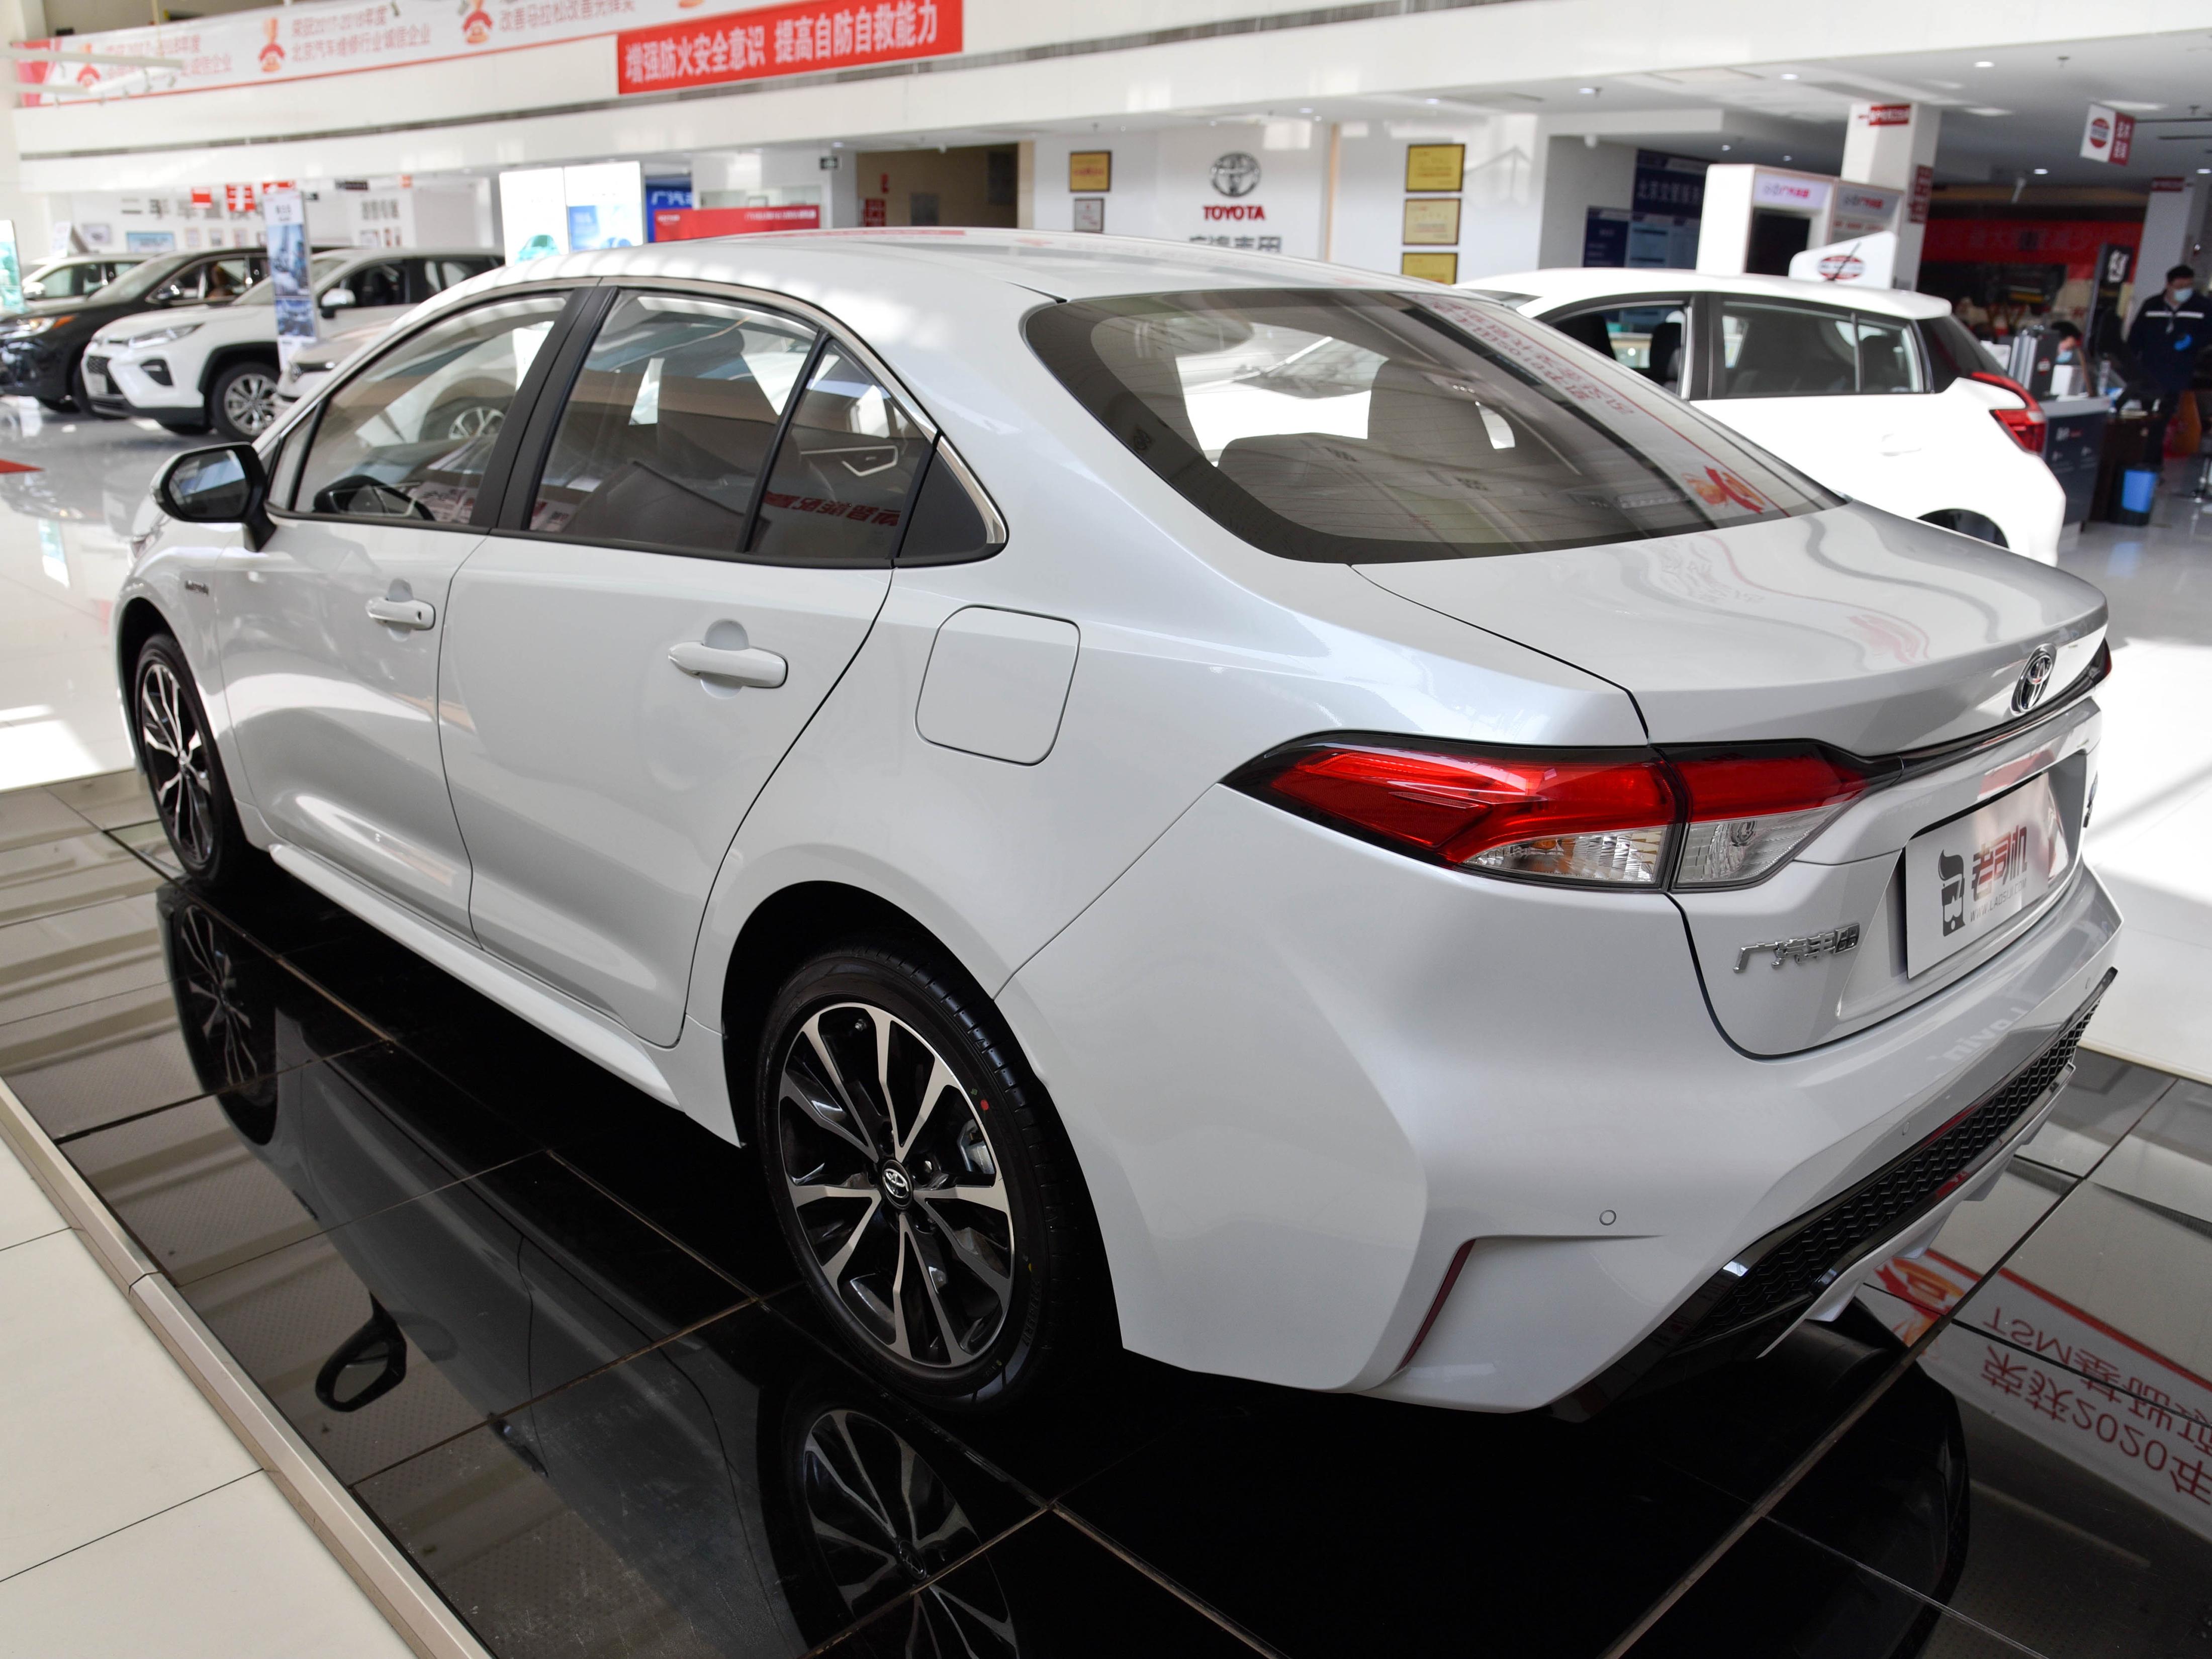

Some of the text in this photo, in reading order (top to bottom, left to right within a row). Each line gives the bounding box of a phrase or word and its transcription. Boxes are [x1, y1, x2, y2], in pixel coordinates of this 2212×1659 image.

[625, 1, 938, 84] 增强防火安全意识 提高自防自救能力
[1203, 205, 1266, 221] TOYOTA
[1971, 825, 2028, 901] 老司机
[1970, 878, 2027, 923] WWW.LAOSIJI.COM
[1733, 923, 1860, 973] 广汽丰田
